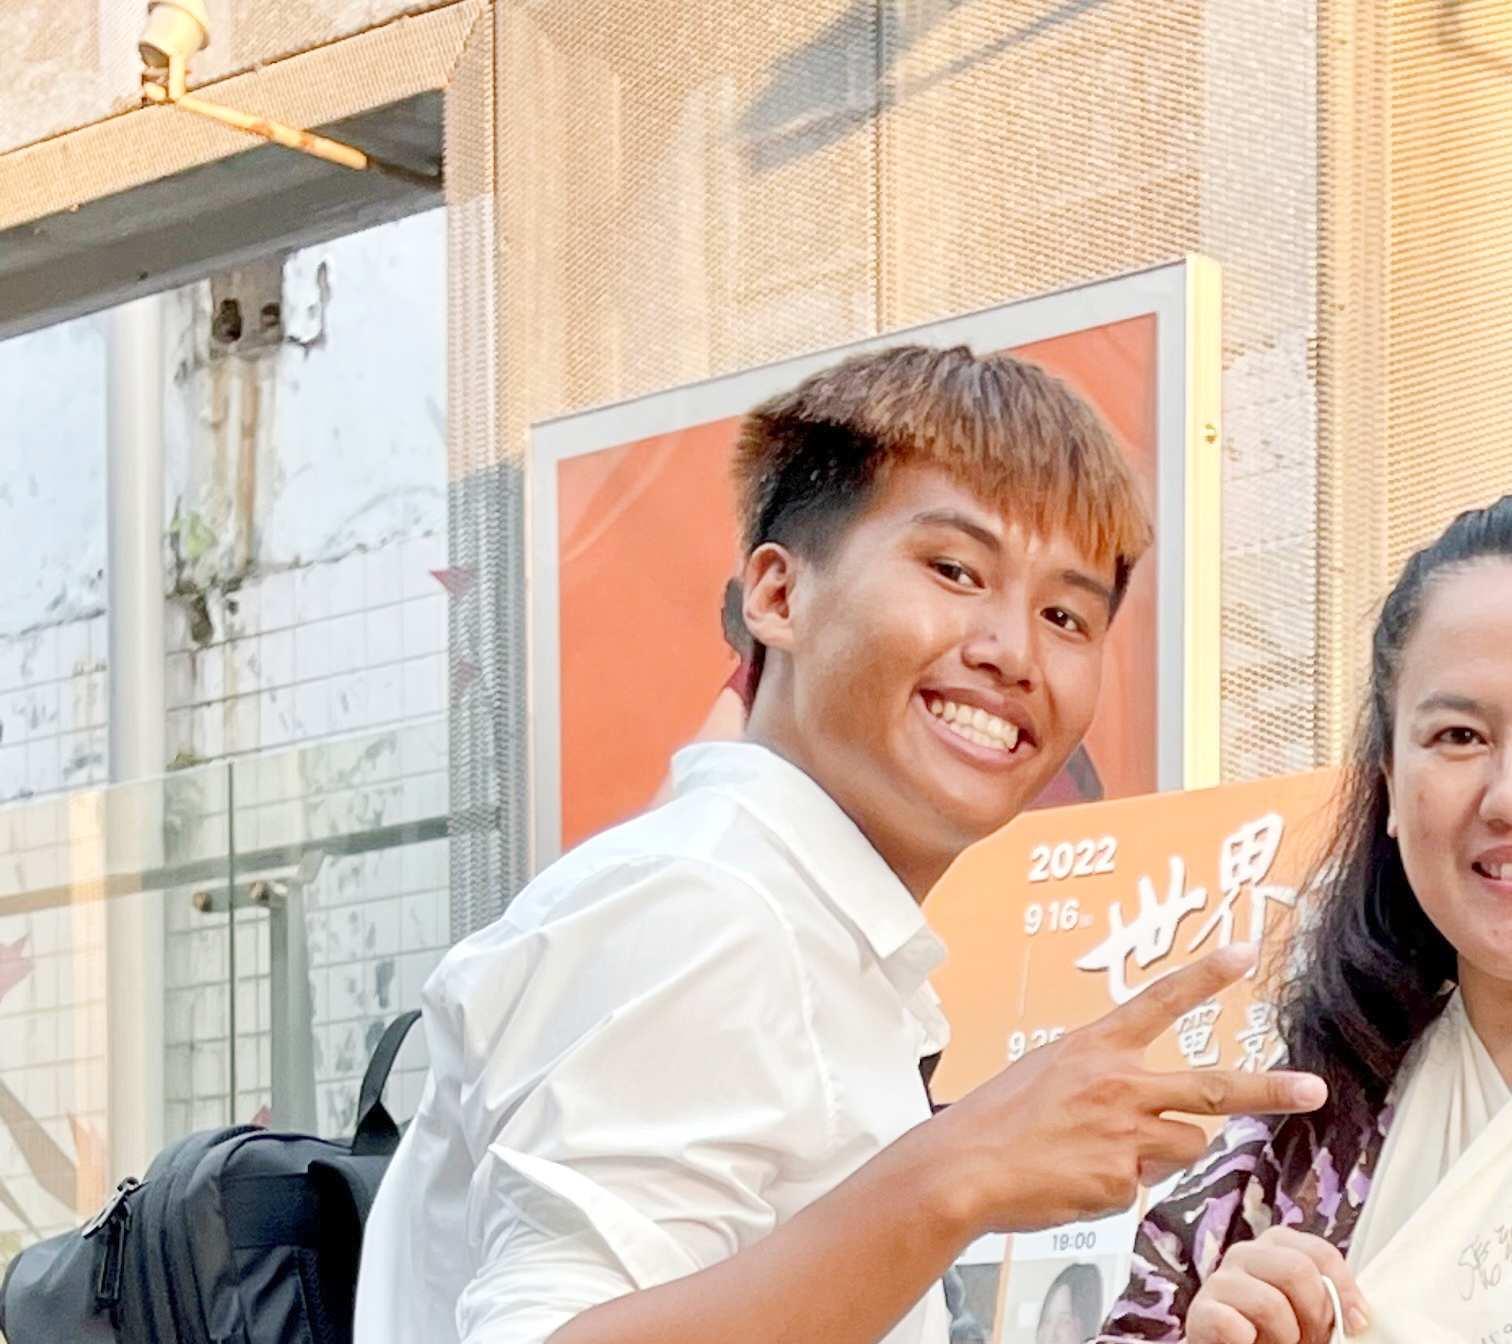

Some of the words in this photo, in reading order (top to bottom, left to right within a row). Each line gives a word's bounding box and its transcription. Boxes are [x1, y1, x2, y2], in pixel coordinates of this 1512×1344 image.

[1028, 837, 1117, 883] 2022
[1074, 812, 1300, 1005] 世界
[1053, 1231, 1096, 1251] 19:00
